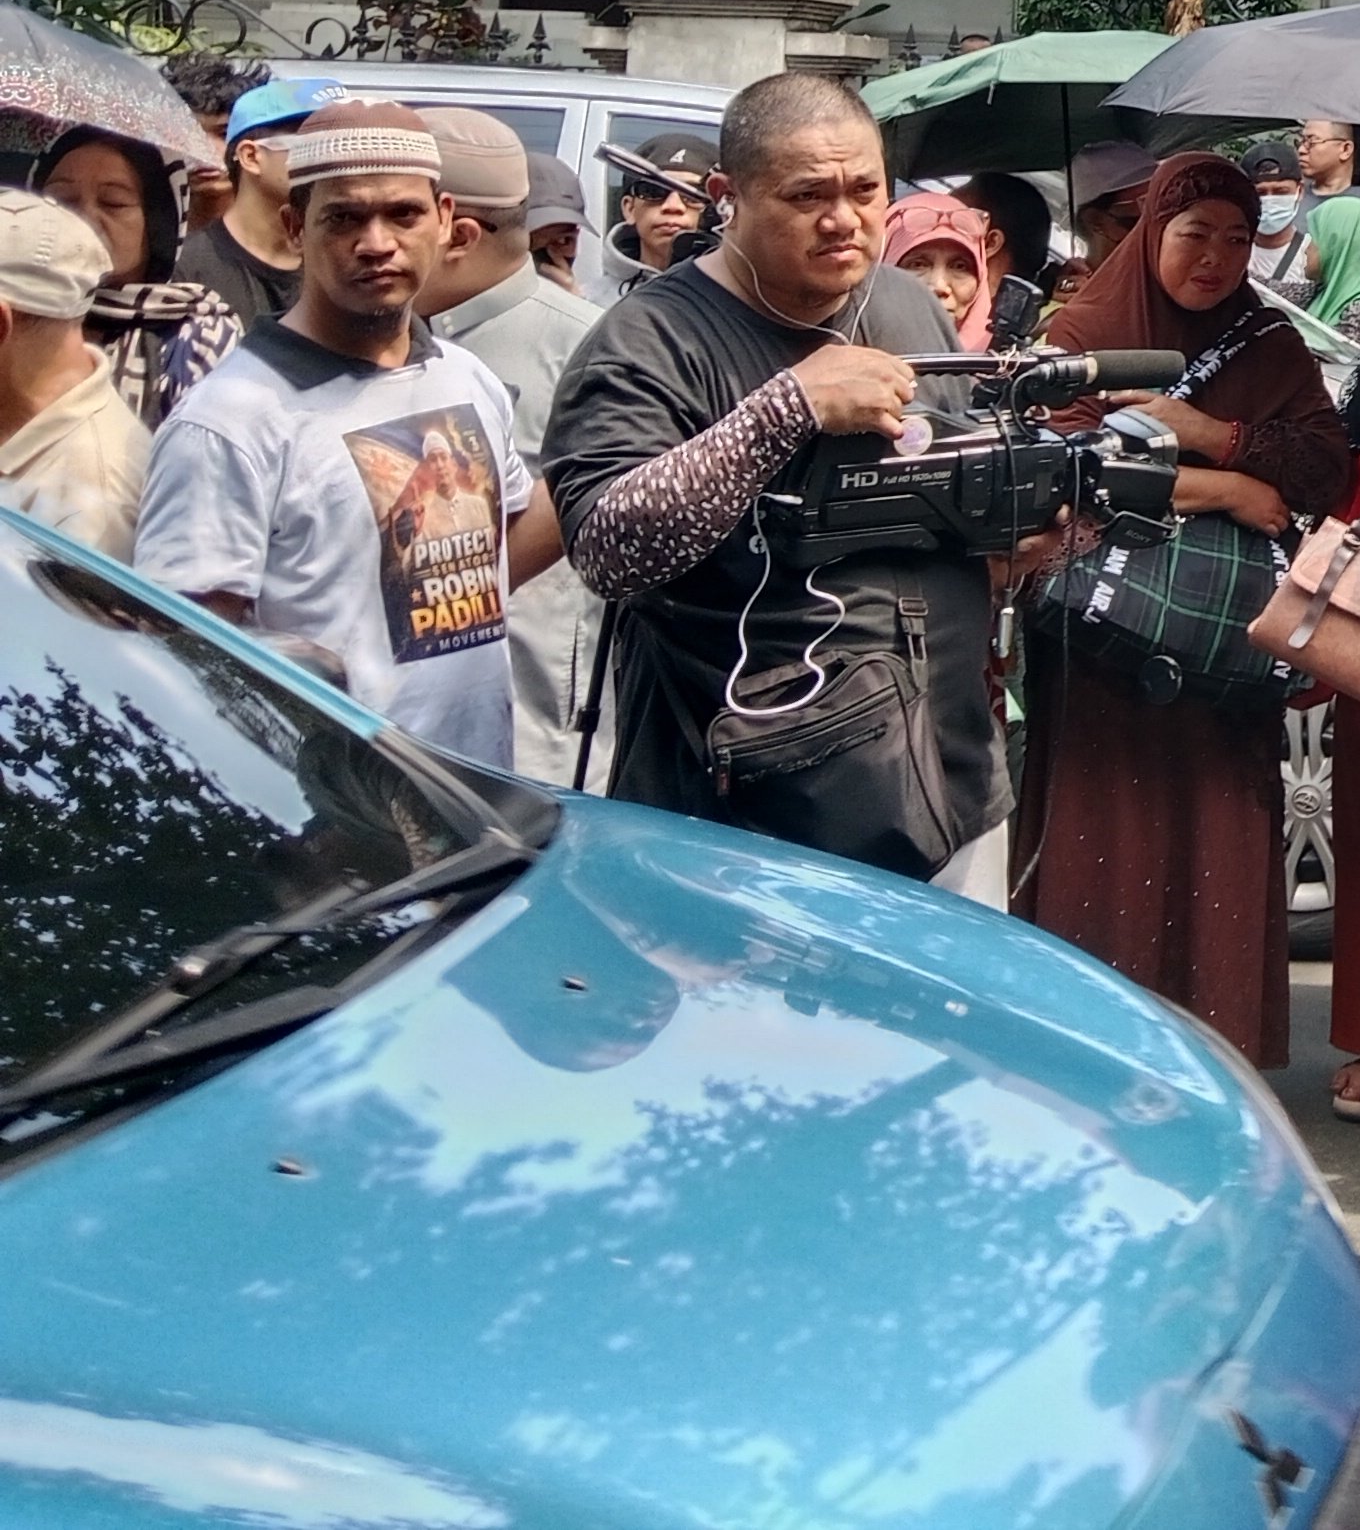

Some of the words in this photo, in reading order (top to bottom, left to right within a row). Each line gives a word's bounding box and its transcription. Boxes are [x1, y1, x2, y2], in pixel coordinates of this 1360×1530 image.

[841, 471, 879, 489] HD
[415, 528, 495, 569] PROTECT
[1102, 545, 1130, 576] JAM
[422, 563, 498, 607] ROBIN
[1089, 580, 1116, 612] AIR
[439, 624, 504, 651] MOVEMENT
